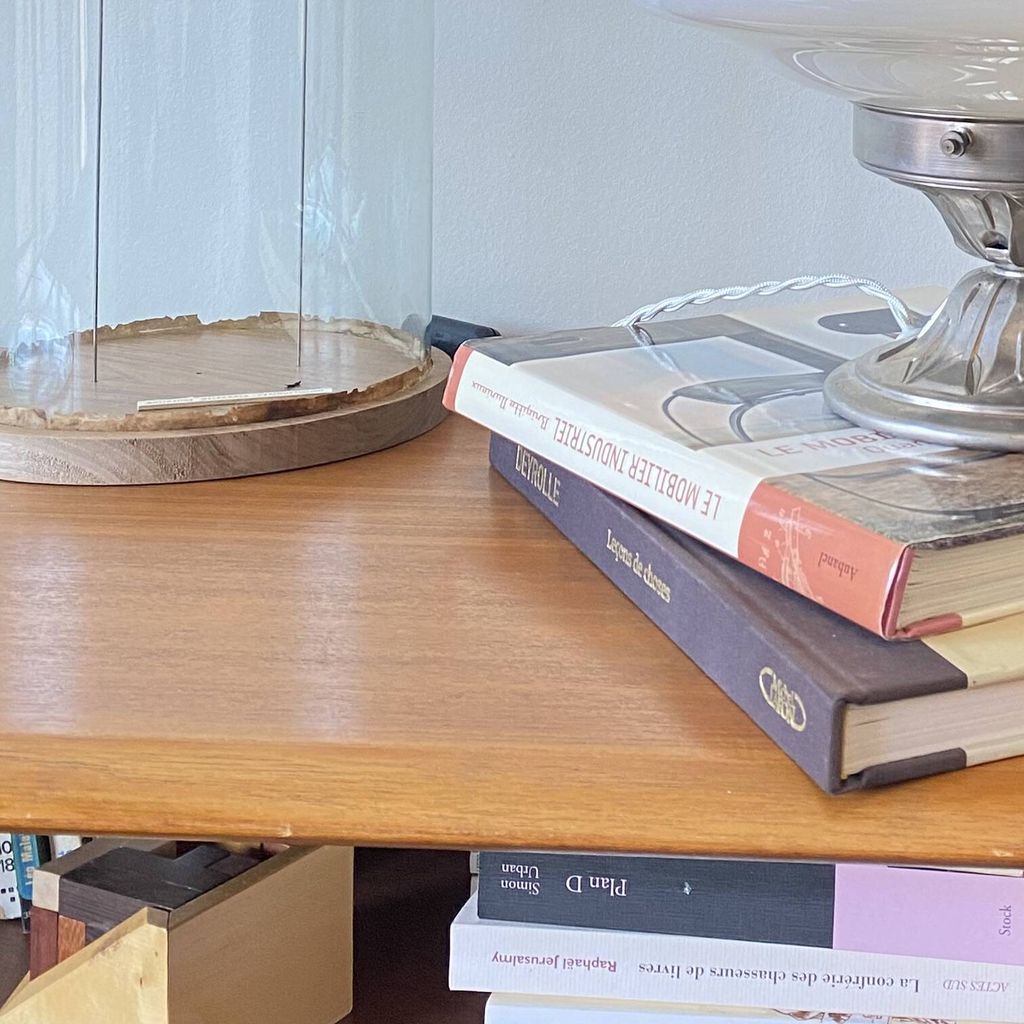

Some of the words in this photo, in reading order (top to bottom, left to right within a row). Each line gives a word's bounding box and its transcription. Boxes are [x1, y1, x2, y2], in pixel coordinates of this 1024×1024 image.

[553, 417, 629, 474] INDUSTRIEL
[757, 444, 803, 457] LE
[802, 429, 893, 451] MOBI
[515, 444, 561, 508] DEYROLLE
[628, 454, 701, 510] MOBILIER
[701, 489, 722, 521] LE
[606, 528, 633, 569] Leçons
[632, 552, 643, 578] de
[643, 564, 672, 604] choses
[501, 863, 540, 879] Urban
[500, 879, 541, 896] Simon
[565, 874, 583, 893] D
[588, 876, 628, 897] Plan
[998, 904, 1013, 937] Stock
[491, 951, 558, 969] Jerusalmy
[562, 955, 617, 973] Raphaël
[638, 963, 681, 980] livres
[686, 965, 705, 981] de
[709, 966, 786, 985] chasseurs
[791, 972, 817, 987] des
[822, 974, 895, 991] confrérie
[900, 978, 920, 993] La
[942, 978, 970, 991] SUD
[969, 979, 1009, 993] ACTES
